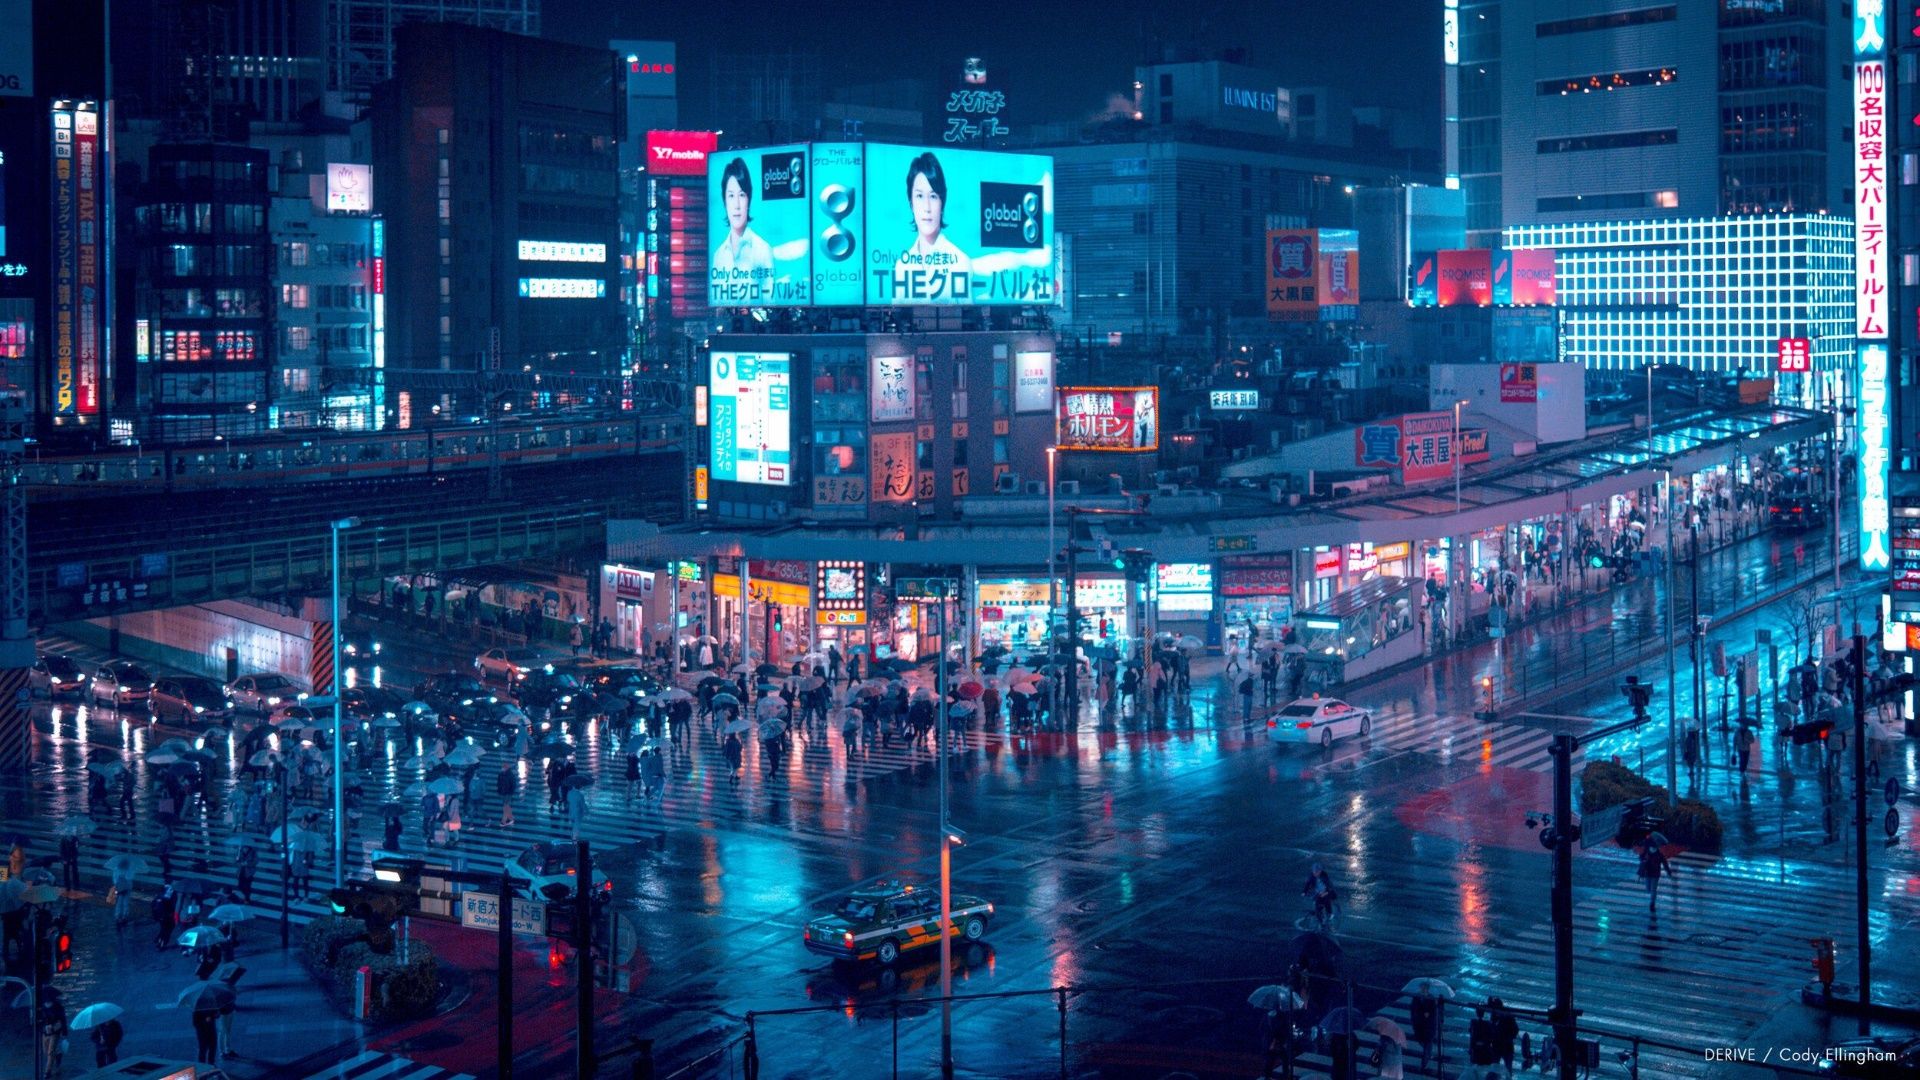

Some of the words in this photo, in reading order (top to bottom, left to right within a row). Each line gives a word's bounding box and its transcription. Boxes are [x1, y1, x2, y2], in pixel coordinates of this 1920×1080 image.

[984, 203, 1022, 232] global
[872, 250, 898, 268] Only
[901, 251, 923, 266] One
[924, 252, 959, 266] の住まい
[711, 266, 730, 283] Only
[732, 266, 749, 279] One
[815, 268, 862, 292] global
[872, 269, 1051, 300] THEグローバル社
[1442, 267, 1488, 282] PROMISE
[1516, 268, 1552, 282] PROMISE
[711, 281, 808, 301] THEグローバル社
[1271, 286, 1315, 302] 大黒屋
[1069, 415, 1129, 438] ホルモン
[716, 404, 724, 471] アイシティ
[887, 438, 902, 450] 3F
[1361, 425, 1400, 464] 質
[1406, 437, 1450, 466] 大黒屋
[619, 572, 641, 589] ATM
[468, 898, 542, 922] 新宿大ード西
